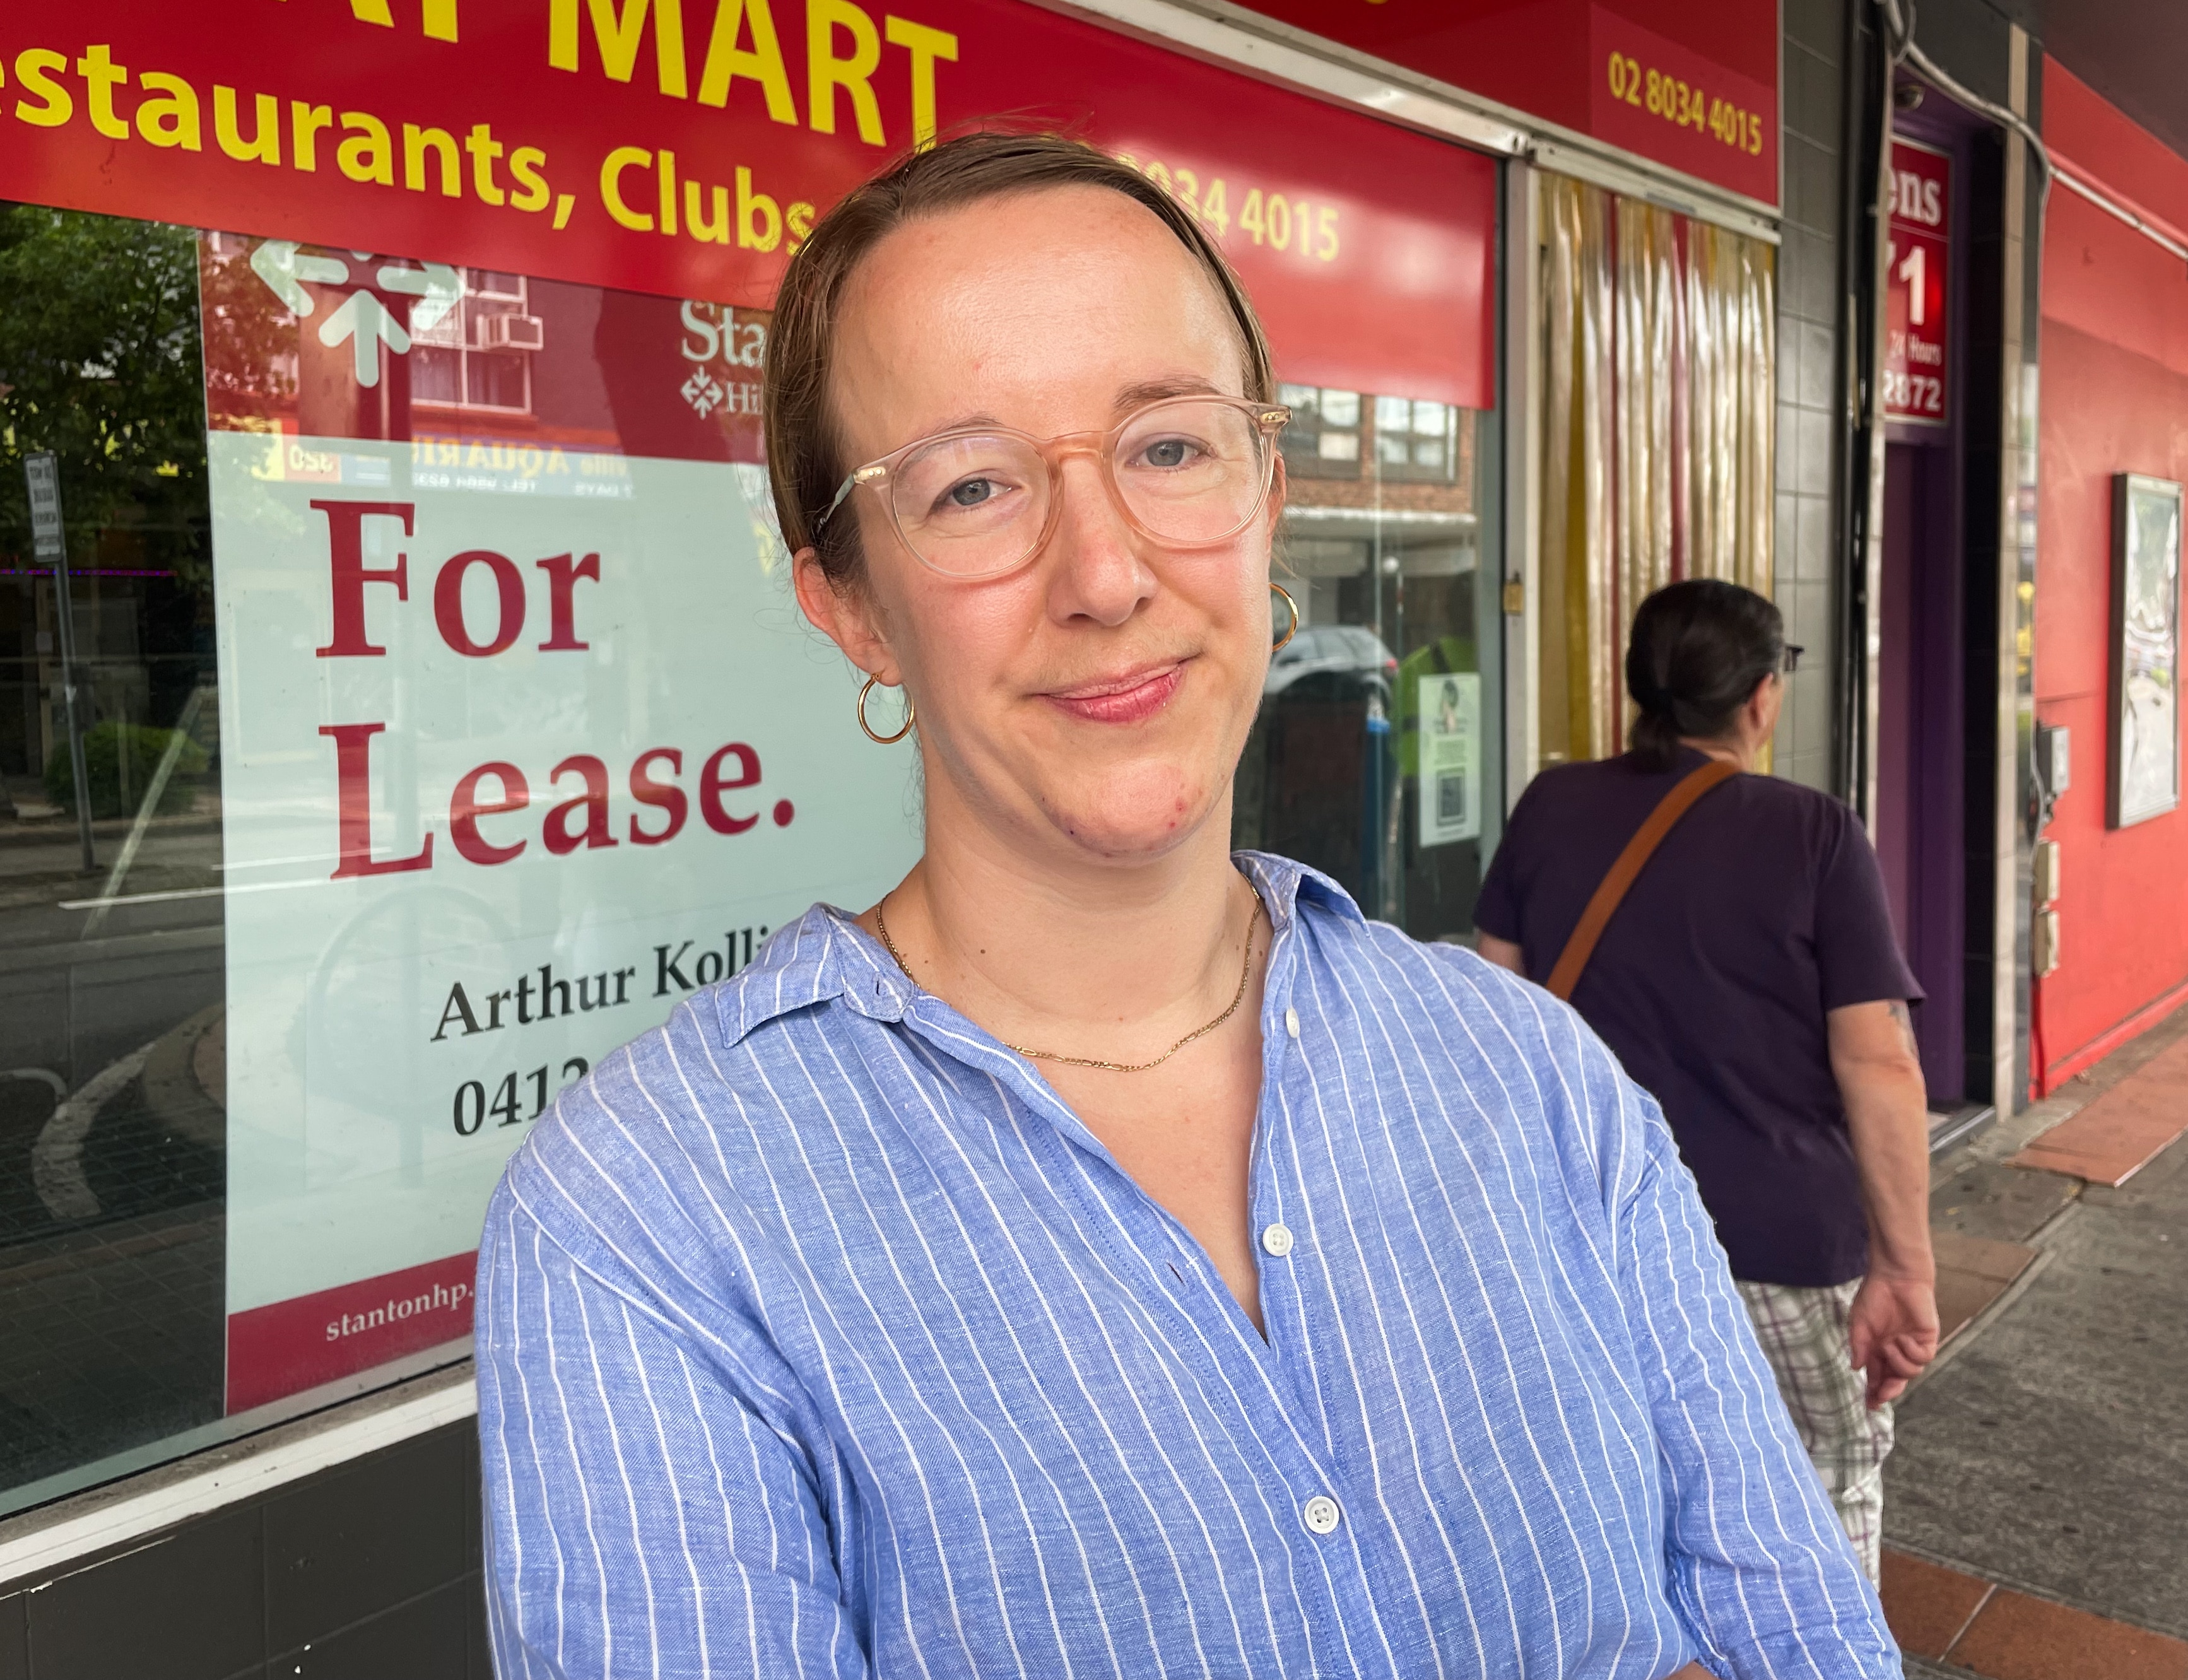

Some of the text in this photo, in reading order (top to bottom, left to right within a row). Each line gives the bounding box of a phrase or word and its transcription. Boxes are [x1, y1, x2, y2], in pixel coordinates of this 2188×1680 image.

[548, 0, 958, 154] MART
[1608, 50, 1763, 157] 02 8034 4015
[0, 44, 816, 256] staurants, Clubs
[1117, 154, 1339, 262] 34 4015
[1907, 332, 1942, 366] Hours
[310, 498, 600, 659] For
[318, 720, 795, 881] Lease.
[430, 962, 636, 1043] Arthur
[326, 1283, 474, 1342] stantonhp.
